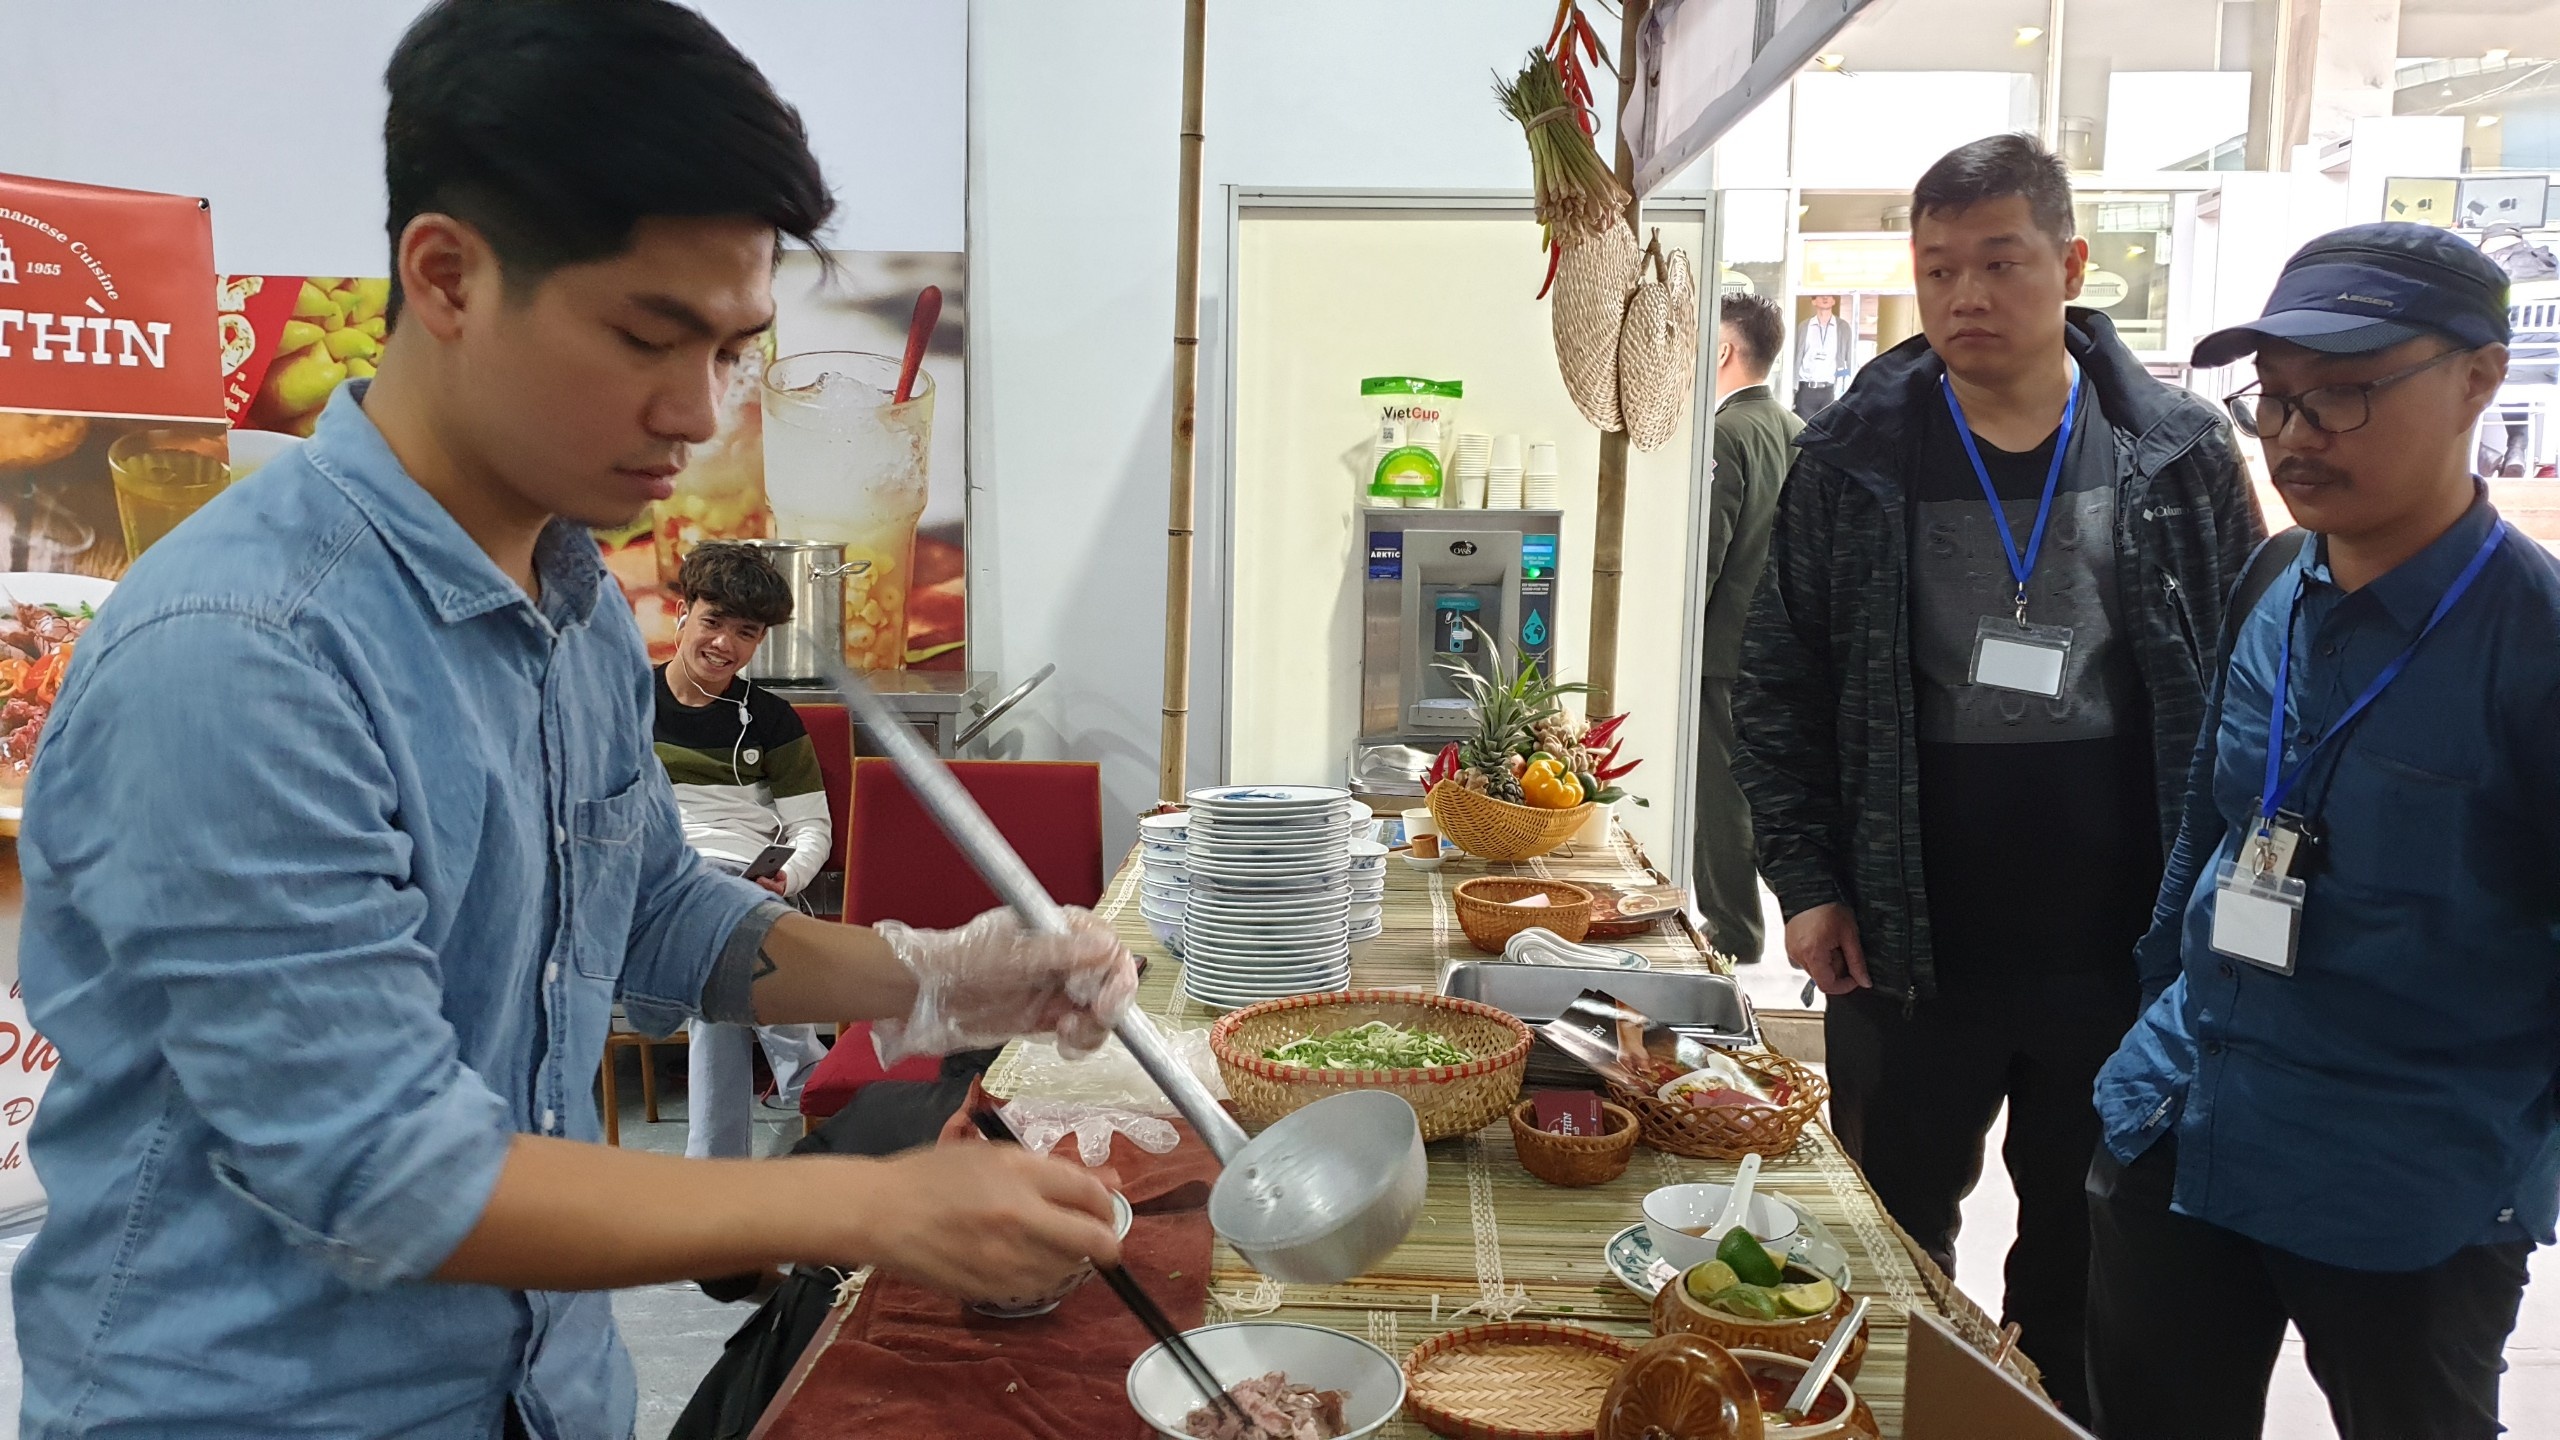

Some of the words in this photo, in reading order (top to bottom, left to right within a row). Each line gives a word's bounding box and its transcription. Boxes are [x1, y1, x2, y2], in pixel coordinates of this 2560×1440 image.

[26, 262, 61, 276] 1955
[70, 241, 119, 300] Cuisine
[1383, 406, 1439, 420] VietCup
[1370, 551, 1401, 559] ARKTIC
